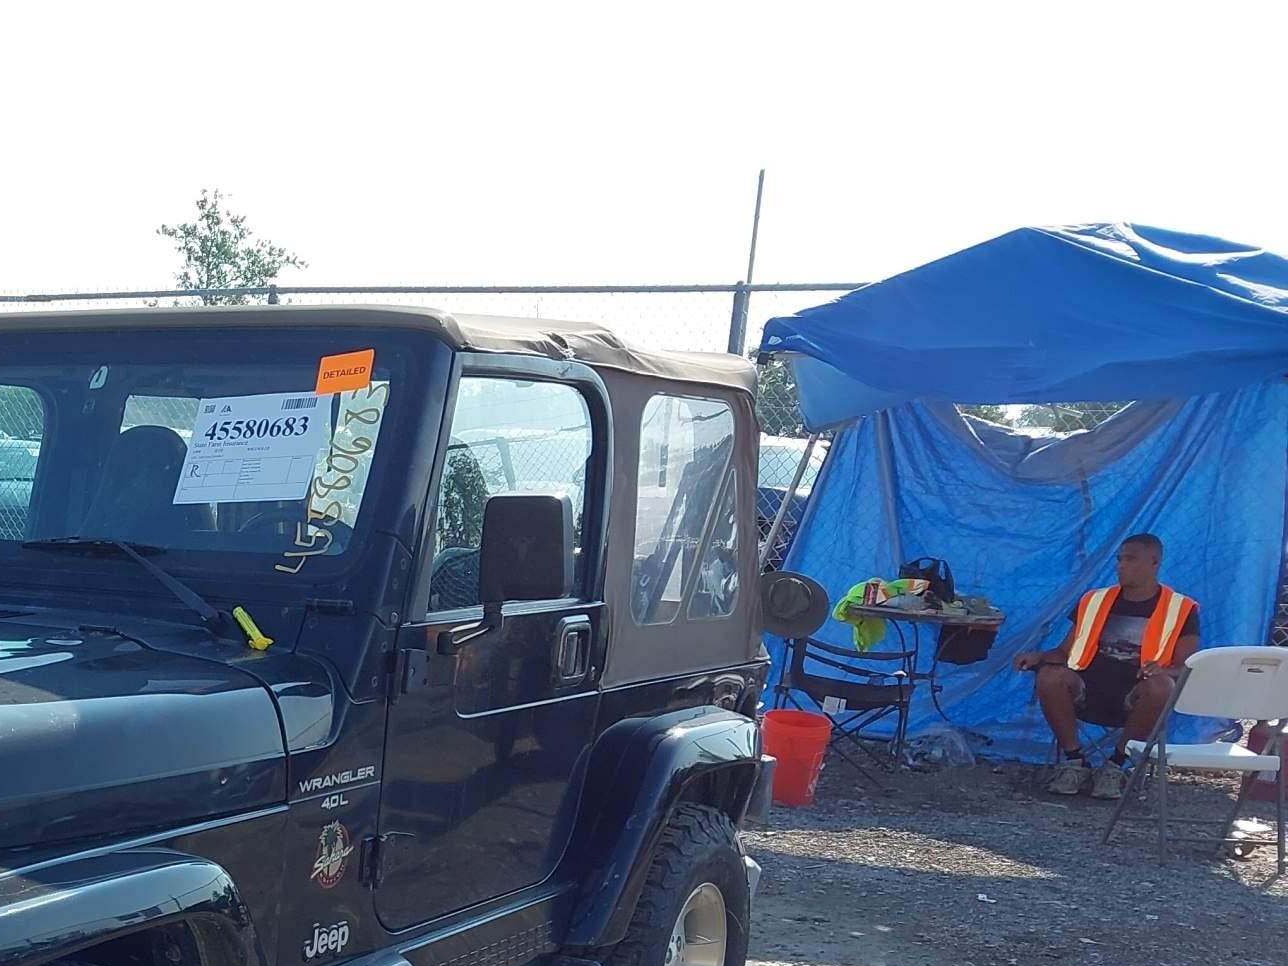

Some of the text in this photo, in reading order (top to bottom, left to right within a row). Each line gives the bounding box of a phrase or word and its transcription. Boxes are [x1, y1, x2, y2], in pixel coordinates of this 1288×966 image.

[323, 366, 366, 380] DETAILED
[204, 416, 310, 441] 45580683
[274, 381, 391, 574] 45580683
[299, 765, 375, 793] WRANGLER
[304, 920, 349, 959] Jeep
